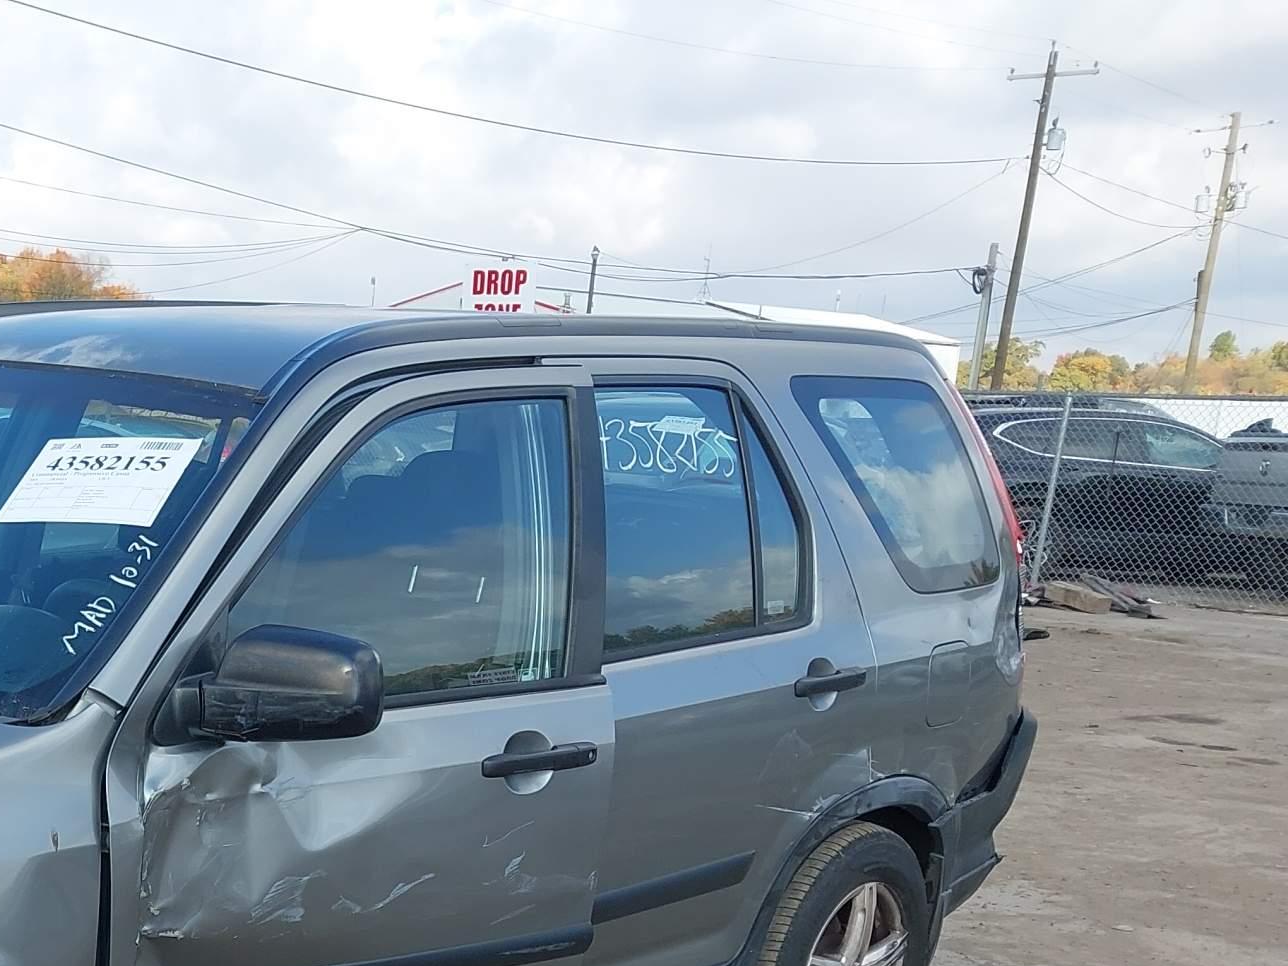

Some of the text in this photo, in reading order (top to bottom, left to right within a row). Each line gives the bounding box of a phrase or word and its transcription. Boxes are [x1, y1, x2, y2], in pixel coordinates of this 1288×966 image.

[472, 269, 528, 296] DROP
[46, 455, 172, 472] 43582155
[61, 596, 117, 656] MAD
